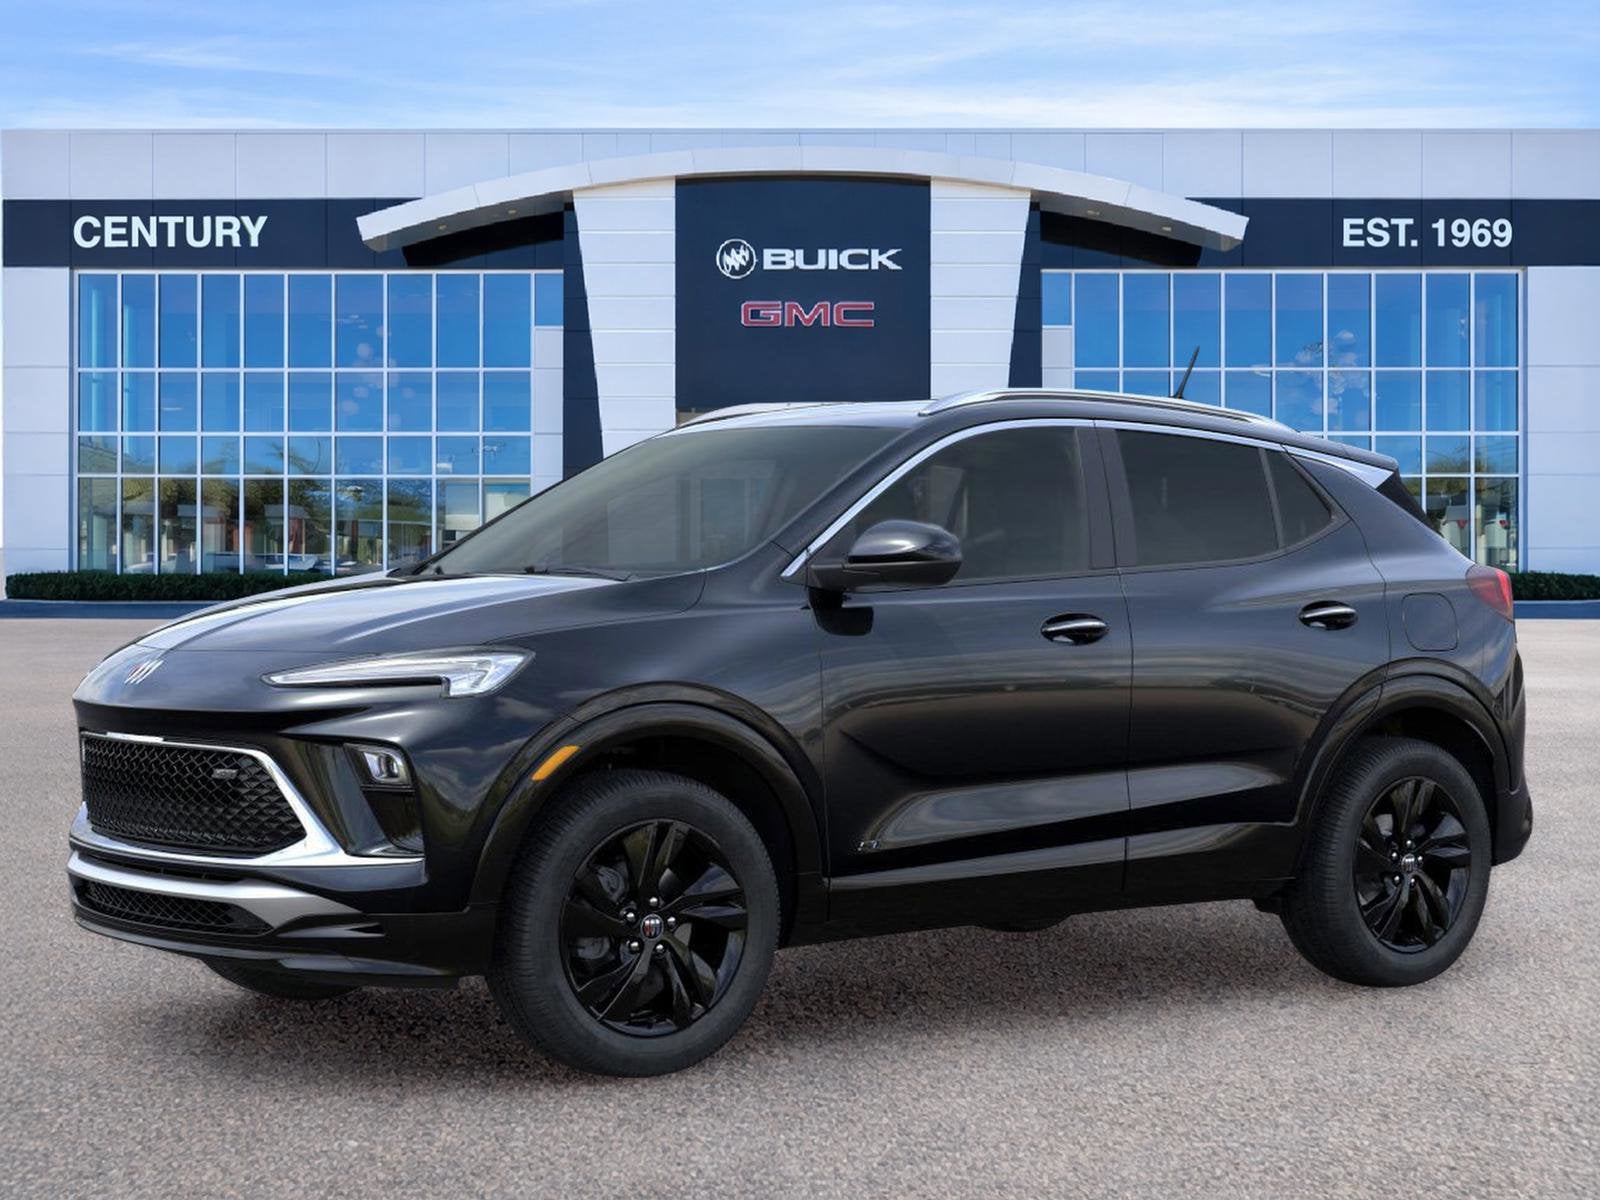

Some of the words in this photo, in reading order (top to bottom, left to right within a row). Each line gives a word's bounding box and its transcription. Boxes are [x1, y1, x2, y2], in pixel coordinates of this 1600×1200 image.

[73, 215, 268, 248] CENTURY
[1342, 217, 1418, 247] EST.
[1431, 218, 1513, 247] 1969
[763, 248, 903, 270] BUICK
[741, 301, 875, 327] GMC
